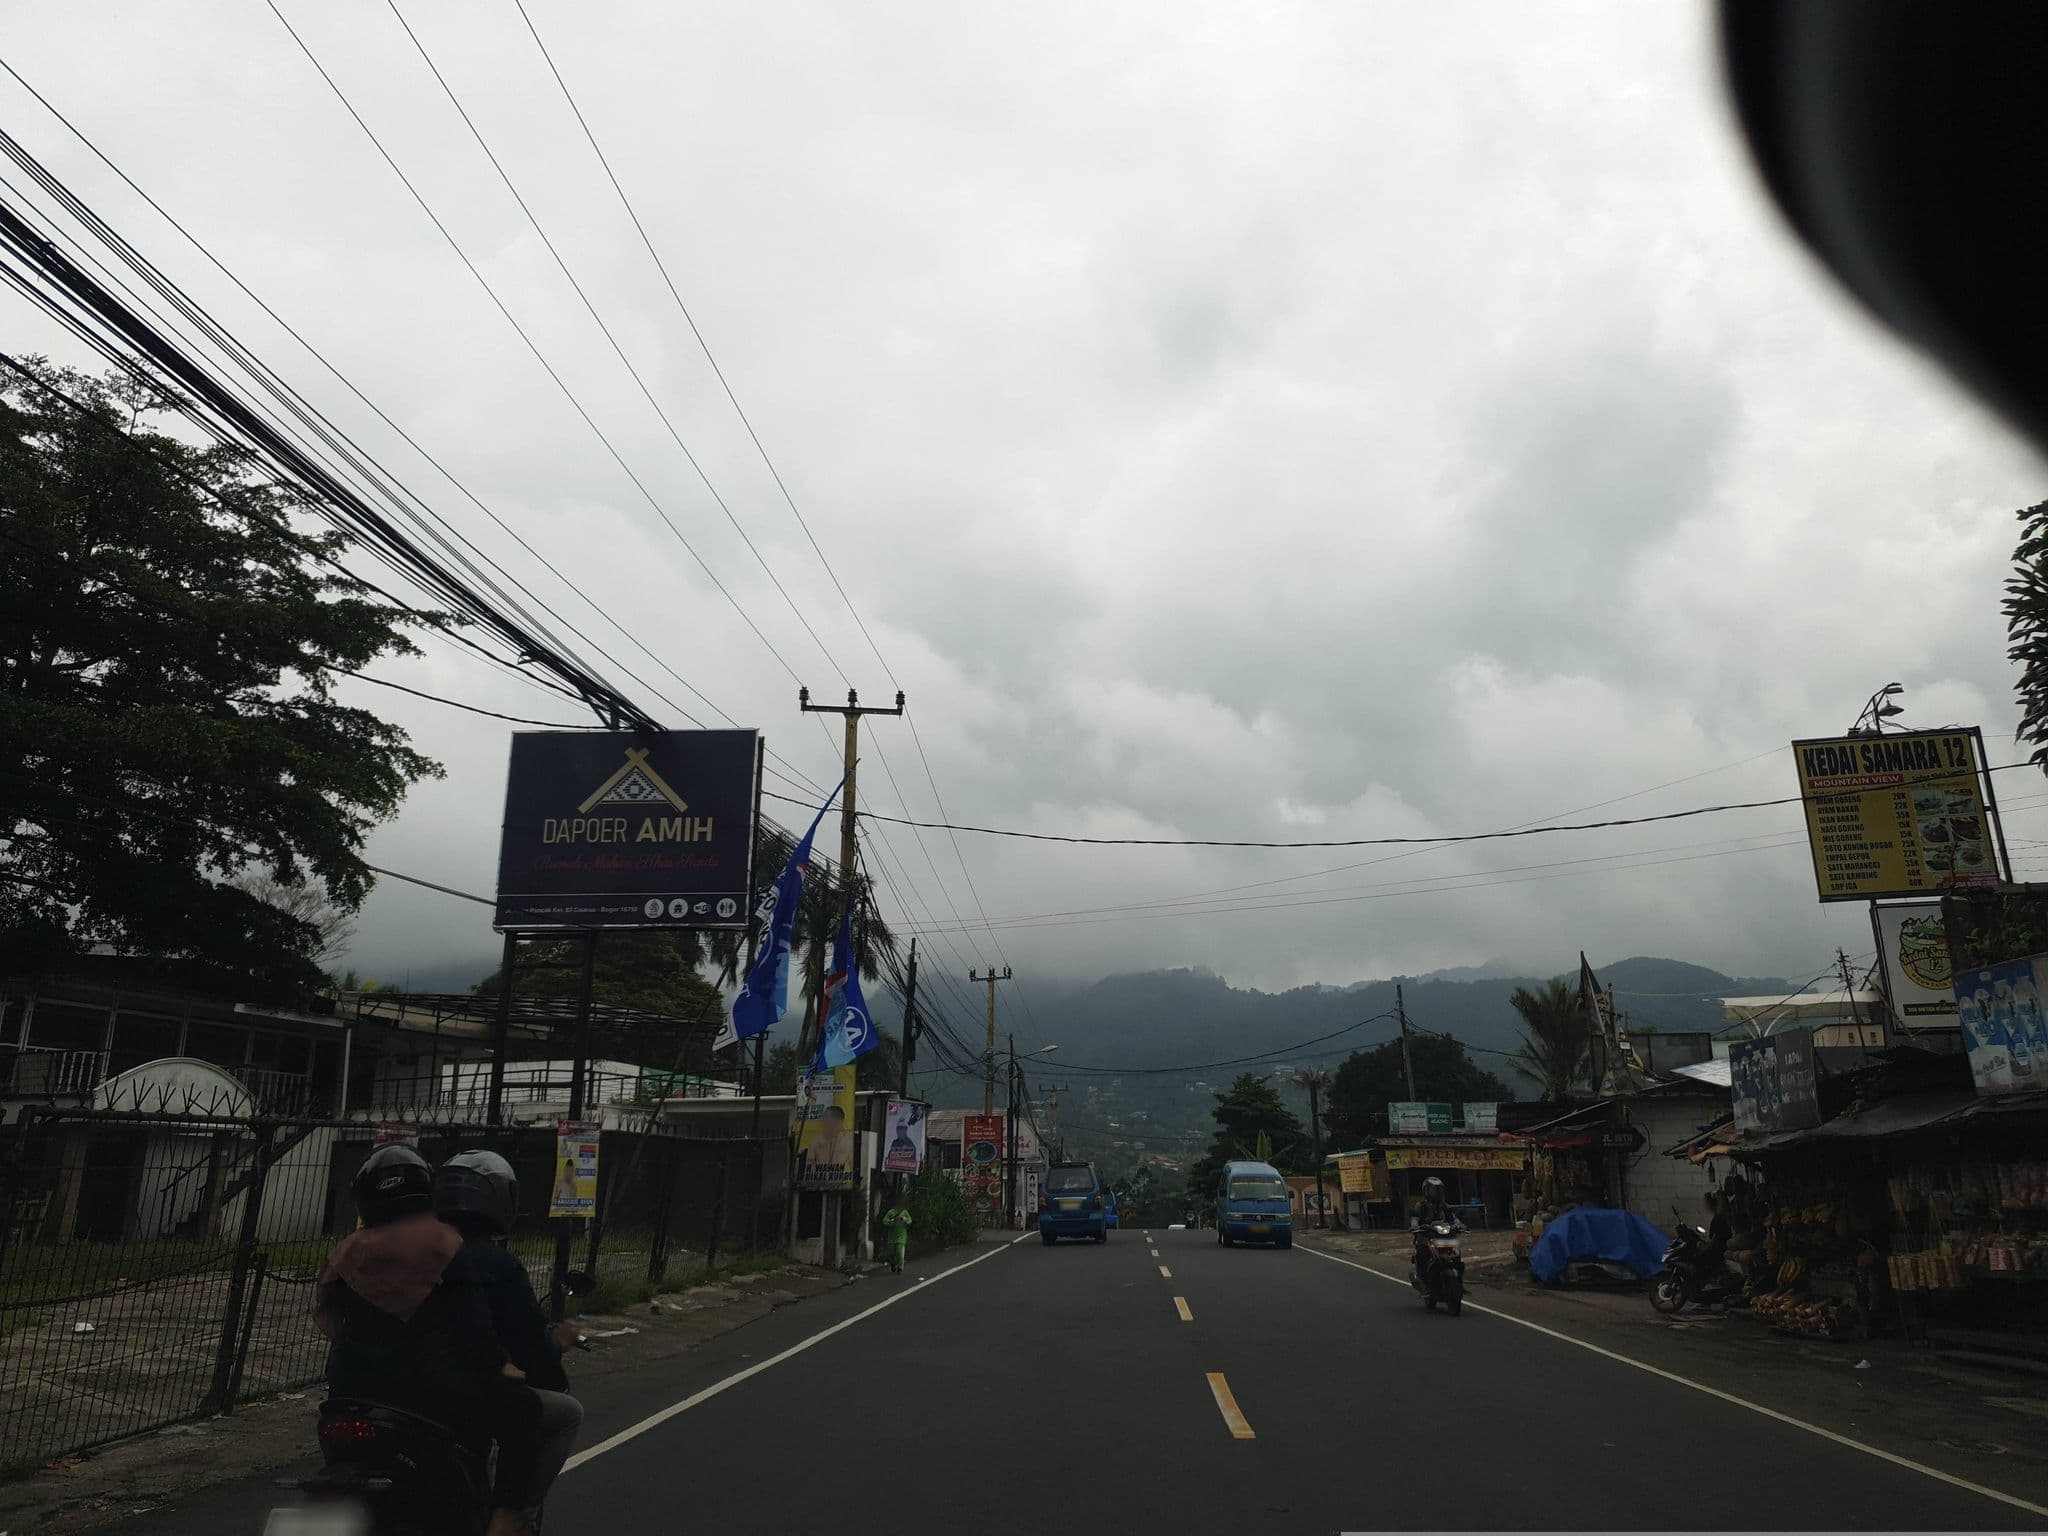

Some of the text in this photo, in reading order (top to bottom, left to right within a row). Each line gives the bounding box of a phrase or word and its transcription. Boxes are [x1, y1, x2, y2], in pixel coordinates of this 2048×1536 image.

[1803, 736, 1968, 778] KEDAI SAMARA 12
[1814, 777, 1869, 789] MOUNTAIN
[1873, 775, 1899, 785] VIEW
[543, 816, 713, 844] DAPOER AMIH
[1821, 825, 1837, 834] NASI
[1838, 823, 1865, 833] GORENG
[815, 1162, 845, 1172] WAWAN
